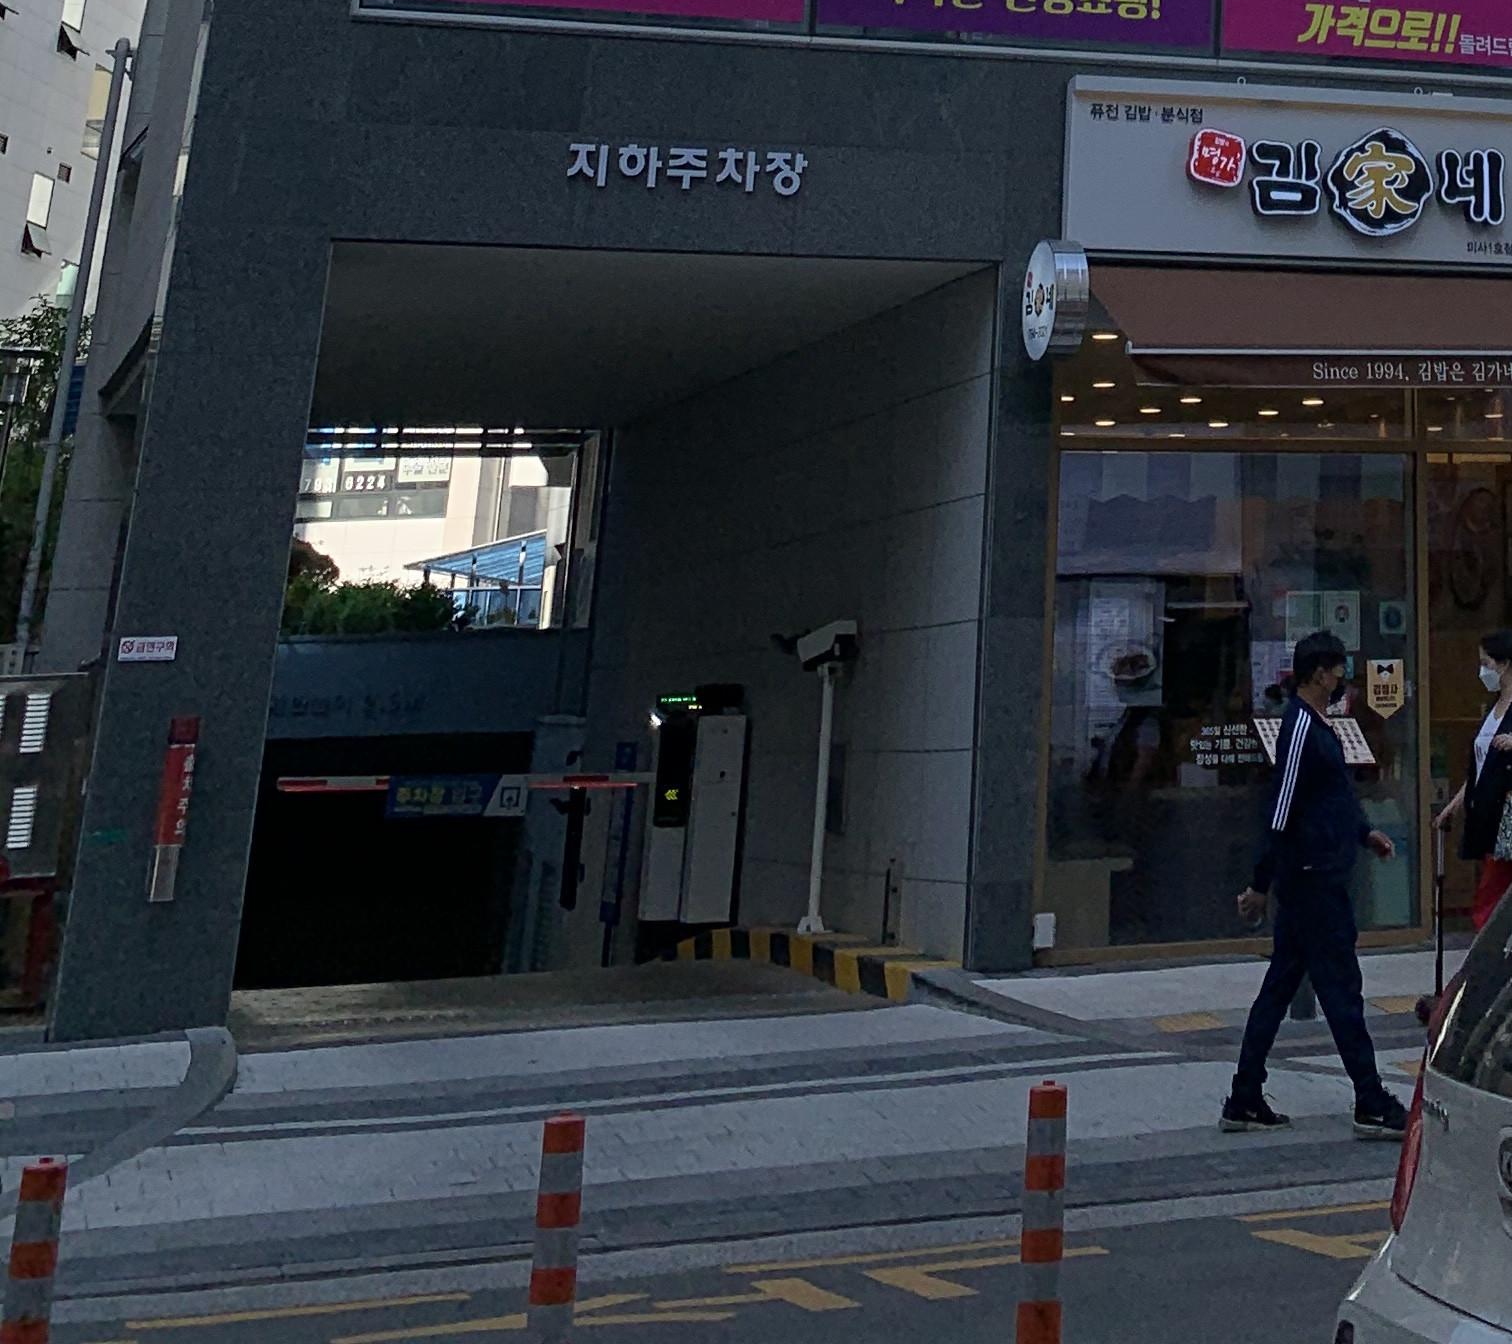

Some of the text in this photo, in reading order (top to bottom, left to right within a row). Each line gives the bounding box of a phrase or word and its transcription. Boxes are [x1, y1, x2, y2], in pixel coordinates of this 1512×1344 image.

[1297, 3, 1462, 54] 가격으로!!
[567, 143, 808, 196] 지하주차장
[1312, 362, 1359, 380] Since
[1418, 361, 1465, 382] 김밥은
